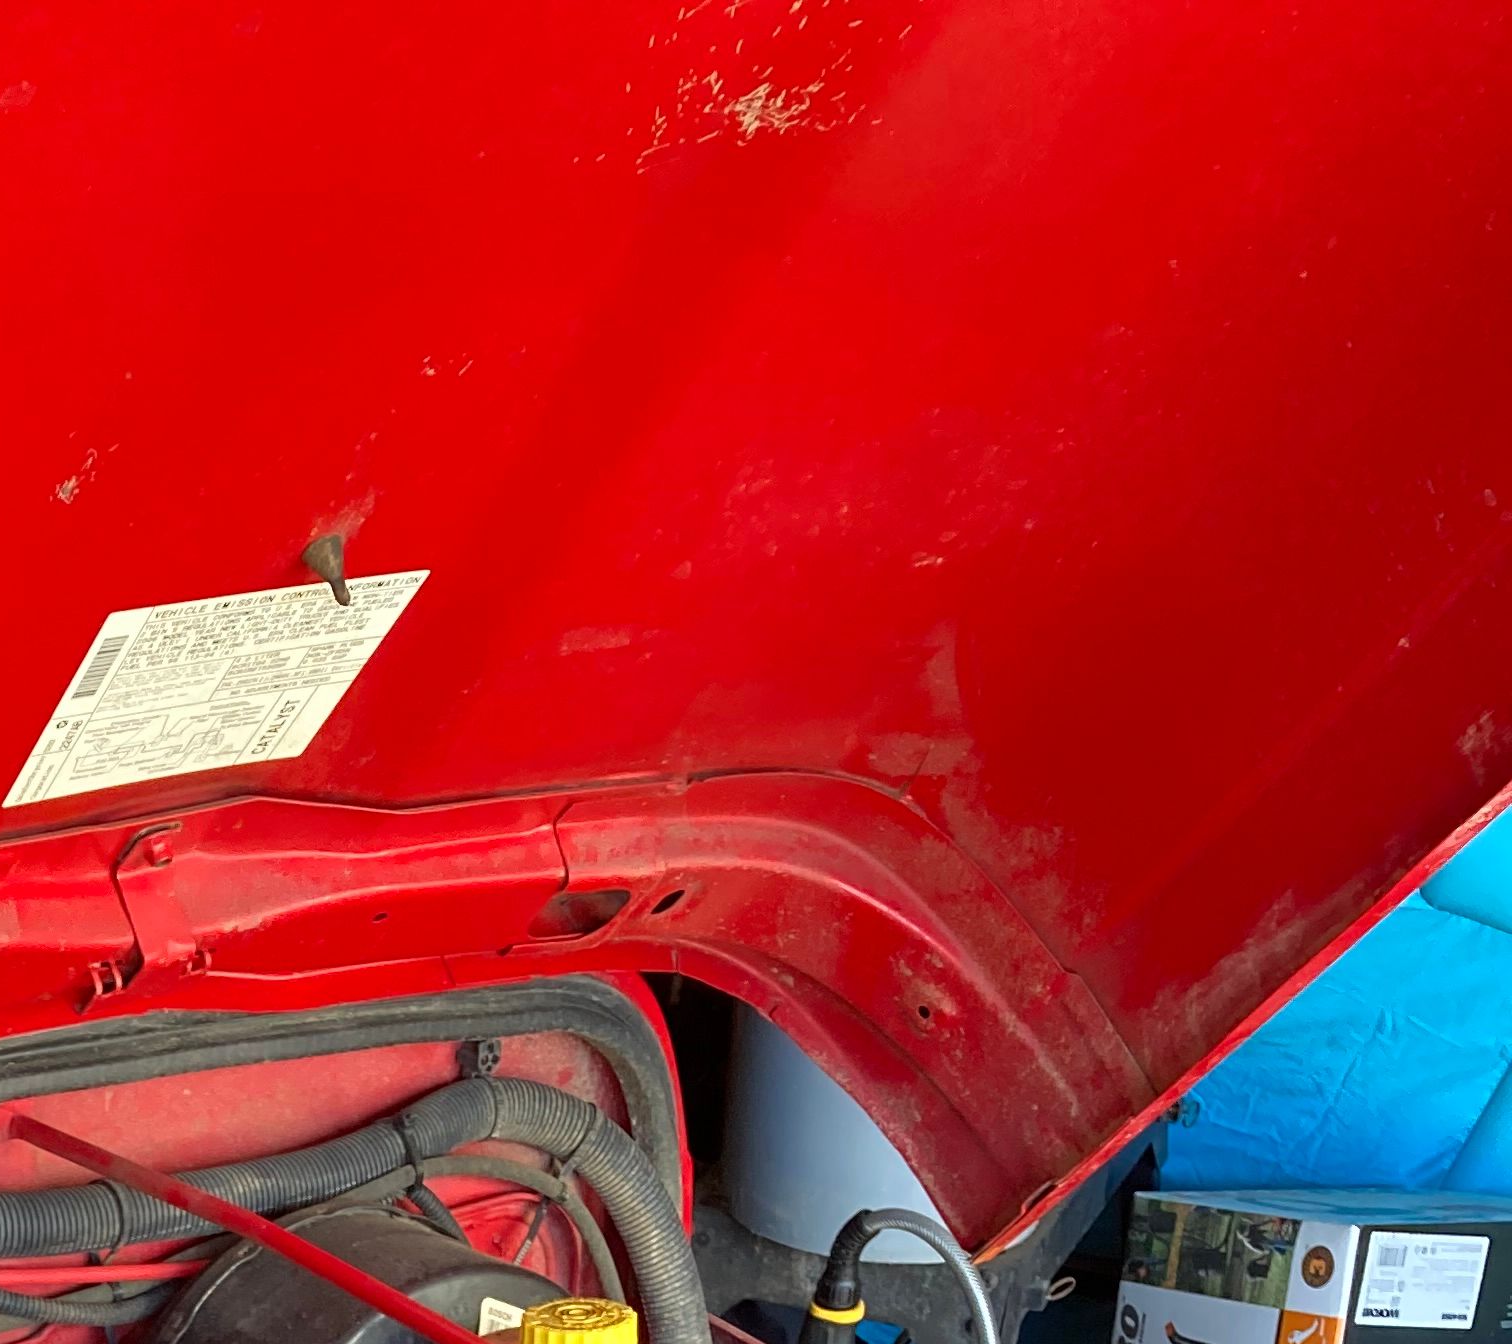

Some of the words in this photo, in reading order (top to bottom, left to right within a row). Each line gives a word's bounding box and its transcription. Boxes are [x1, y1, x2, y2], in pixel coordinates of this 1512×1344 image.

[153, 603, 209, 619] VEHICLE
[212, 594, 276, 611] EMISSION
[278, 586, 334, 602] CONTROL
[344, 574, 423, 593] NFORMATION
[251, 700, 300, 754] CATALYST
